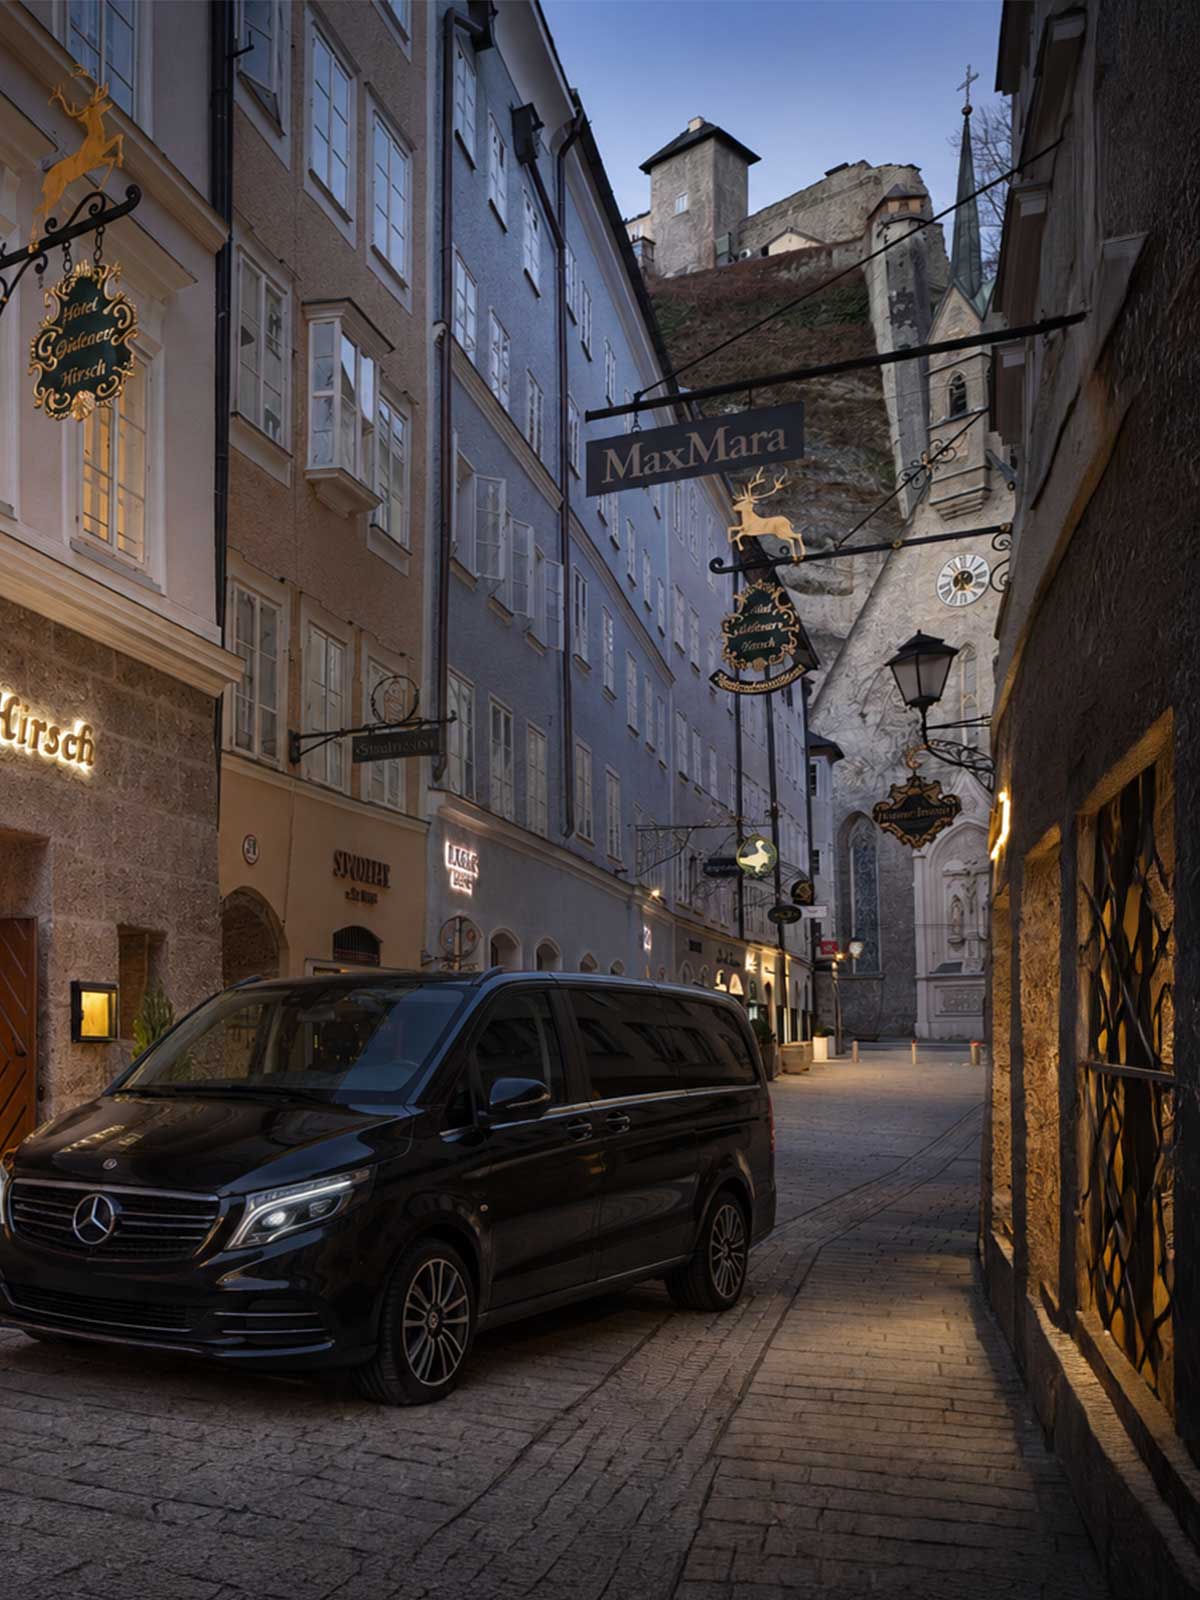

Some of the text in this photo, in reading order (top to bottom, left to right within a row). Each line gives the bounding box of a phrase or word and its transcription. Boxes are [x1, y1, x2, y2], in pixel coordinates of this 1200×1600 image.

[63, 297, 99, 323] Hotel
[56, 327, 116, 360] Goldener
[62, 358, 106, 387] Hirsch
[601, 425, 788, 484] MaxMara
